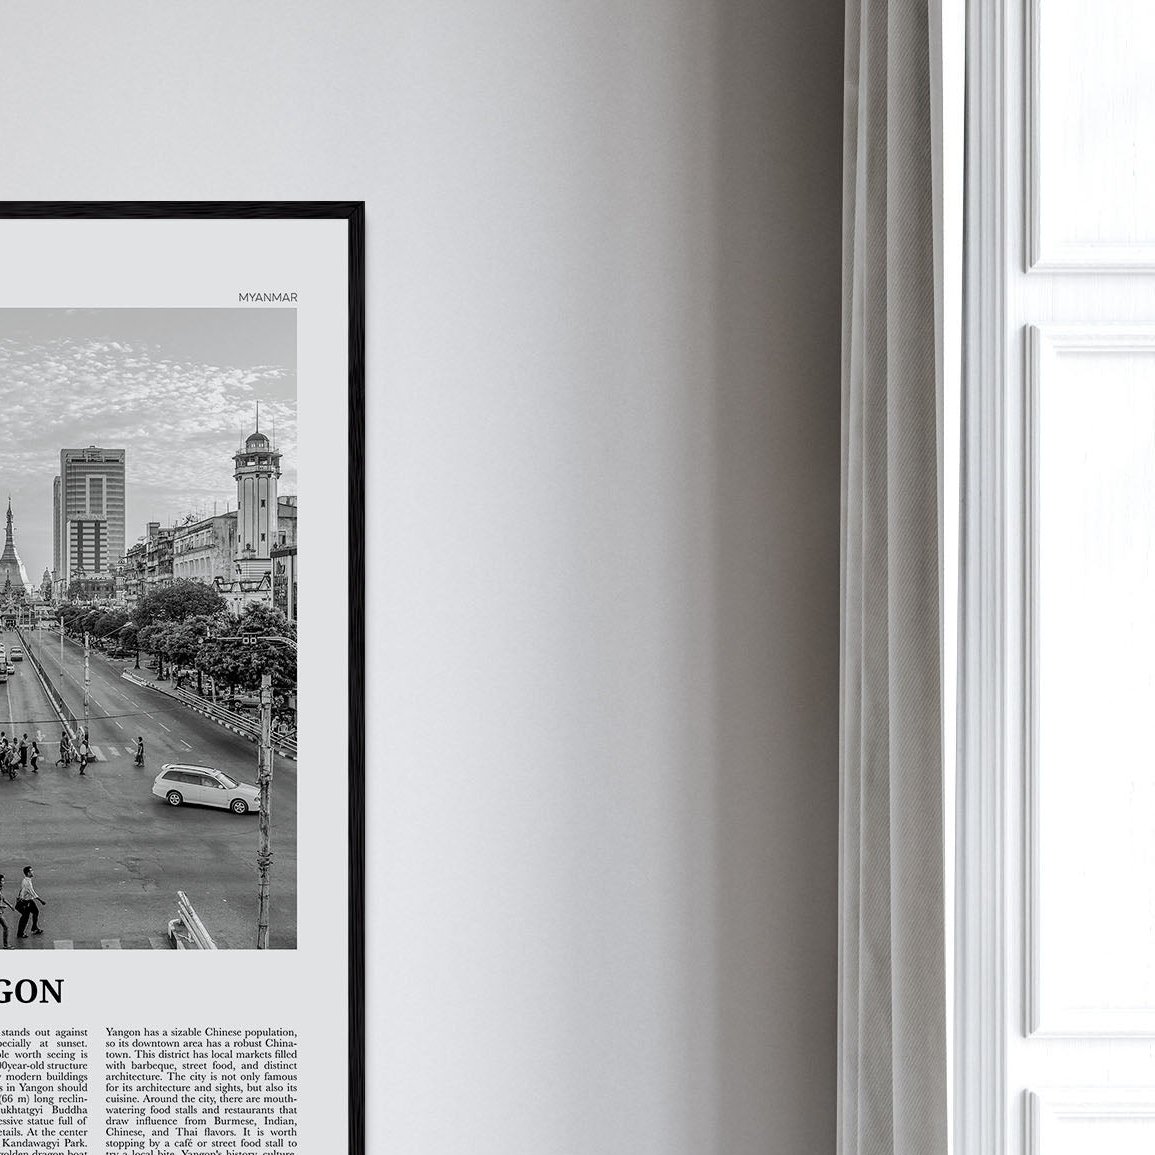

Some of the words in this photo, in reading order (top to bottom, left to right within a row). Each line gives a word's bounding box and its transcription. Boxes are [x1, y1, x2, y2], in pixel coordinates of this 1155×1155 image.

[238, 292, 298, 303] MYANMAR
[1, 1028, 30, 1036] stands
[55, 1028, 88, 1039] against
[106, 1028, 140, 1039] Yangon
[144, 1028, 159, 1036] has
[171, 1028, 201, 1036] sizable
[205, 1028, 242, 1036] Chinese
[245, 1028, 297, 1039] population,
[15, 1050, 41, 1058] worth
[47, 1050, 76, 1061] seeing
[81, 1050, 88, 1058] is
[134, 1050, 155, 1058] This
[158, 1050, 190, 1058] district
[193, 1050, 208, 1058] has
[212, 1050, 233, 1058] local
[236, 1050, 272, 1058] markets
[275, 1050, 297, 1058] filled
[106, 1061, 125, 1070] with
[131, 1061, 177, 1072] barbeque,
[213, 1061, 236, 1071] food,
[241, 1061, 258, 1070] and
[264, 1061, 297, 1070] distinct
[6, 1072, 42, 1081] modern
[47, 1072, 88, 1083] buildings
[106, 1072, 162, 1081] architecture.
[167, 1072, 186, 1081] The
[190, 1072, 206, 1083] city
[211, 1072, 217, 1081] is
[240, 1072, 260, 1083] only
[265, 1072, 297, 1081] famous
[7, 1083, 15, 1092] in
[19, 1083, 54, 1094] Yangon
[57, 1083, 88, 1092] should
[106, 1083, 119, 1092] for
[123, 1083, 133, 1092] its
[136, 1083, 191, 1092] architecture
[194, 1083, 212, 1092] and
[215, 1083, 243, 1094] sights,
[247, 1083, 262, 1092] but
[266, 1083, 283, 1092] also
[287, 1083, 297, 1092] its
[52, 1105, 88, 1114] Buddha
[106, 1105, 146, 1116] watering
[151, 1105, 170, 1114] food
[175, 1105, 197, 1114] stalls
[202, 1105, 219, 1114] and
[279, 1105, 297, 1114] that
[59, 1116, 73, 1125] full
[77, 1116, 88, 1125] of
